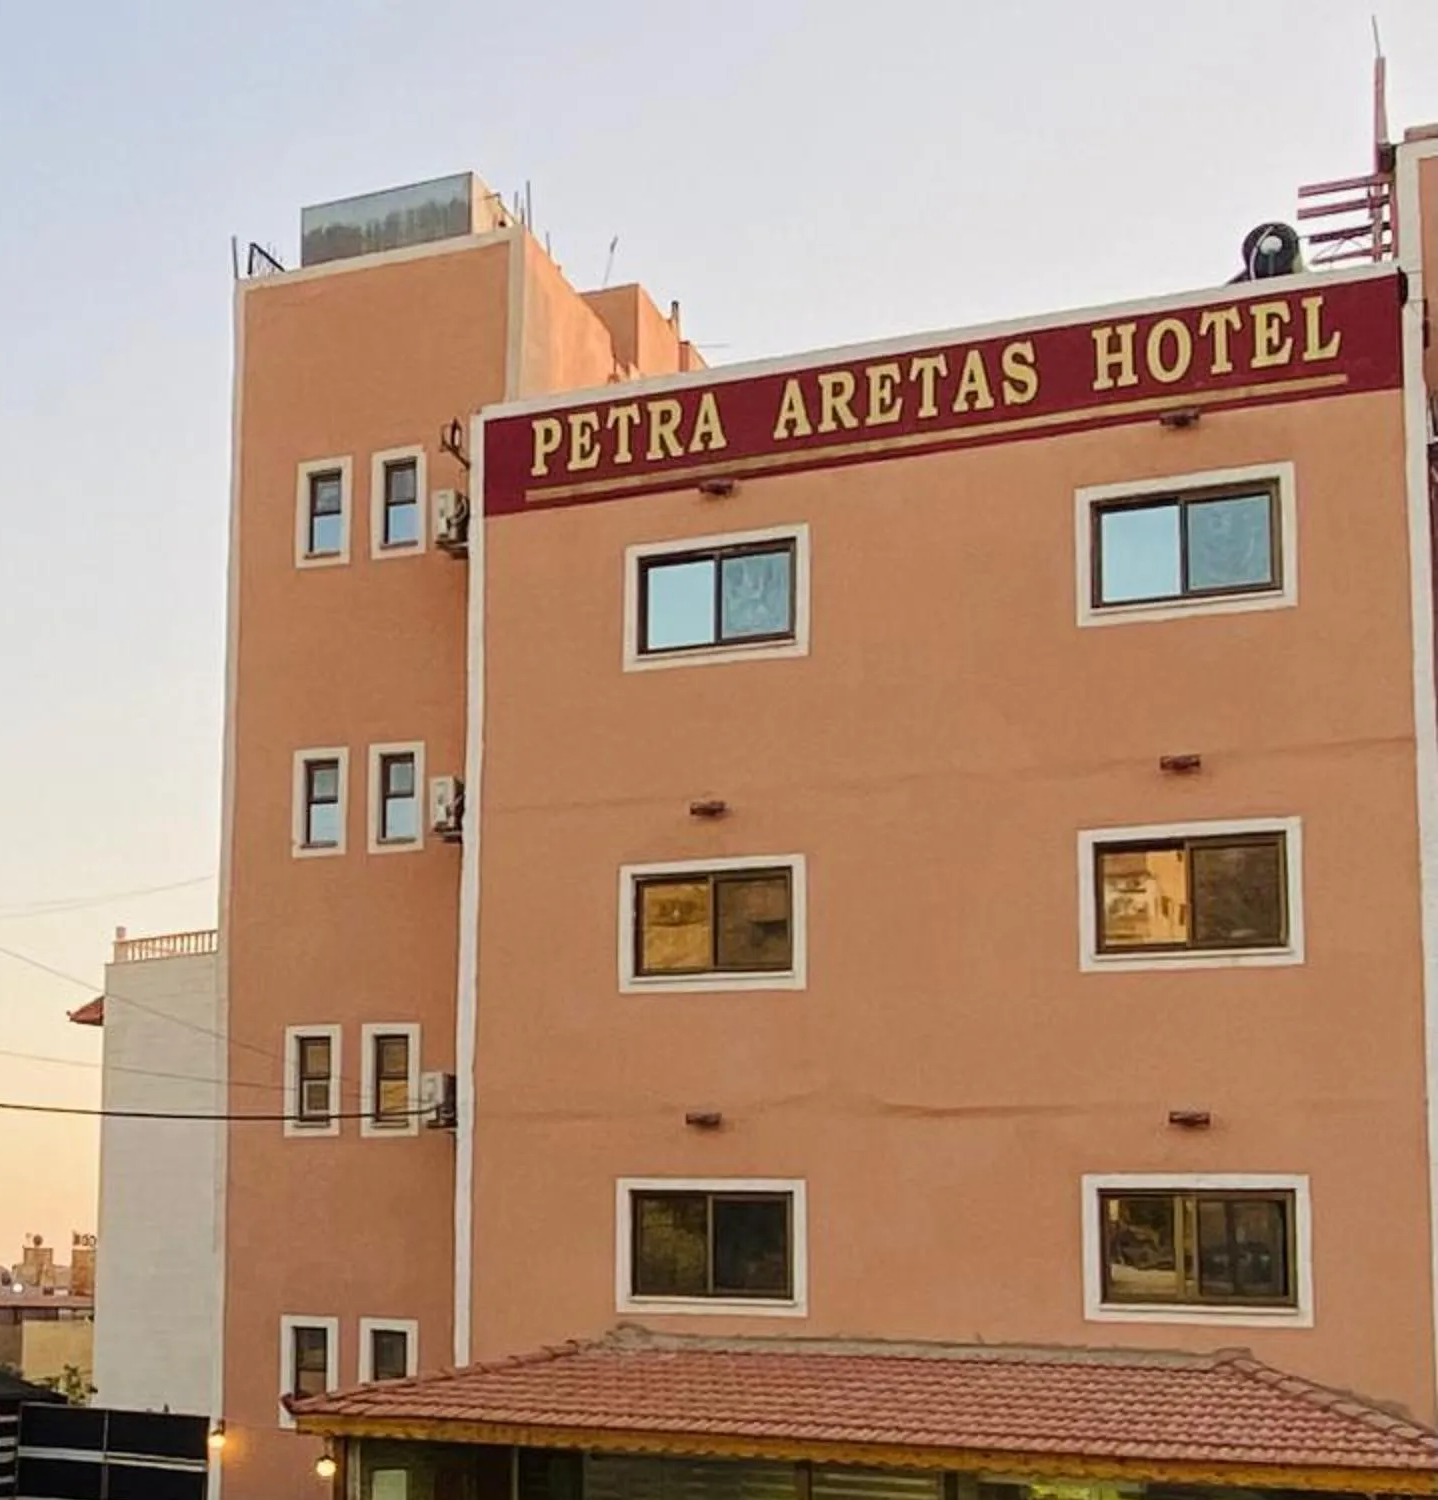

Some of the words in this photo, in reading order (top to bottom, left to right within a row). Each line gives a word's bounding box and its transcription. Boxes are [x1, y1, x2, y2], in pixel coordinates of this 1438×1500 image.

[531, 391, 727, 476] PETRA
[772, 341, 1040, 442] ARETAS
[1091, 295, 1343, 391] HOTEL
